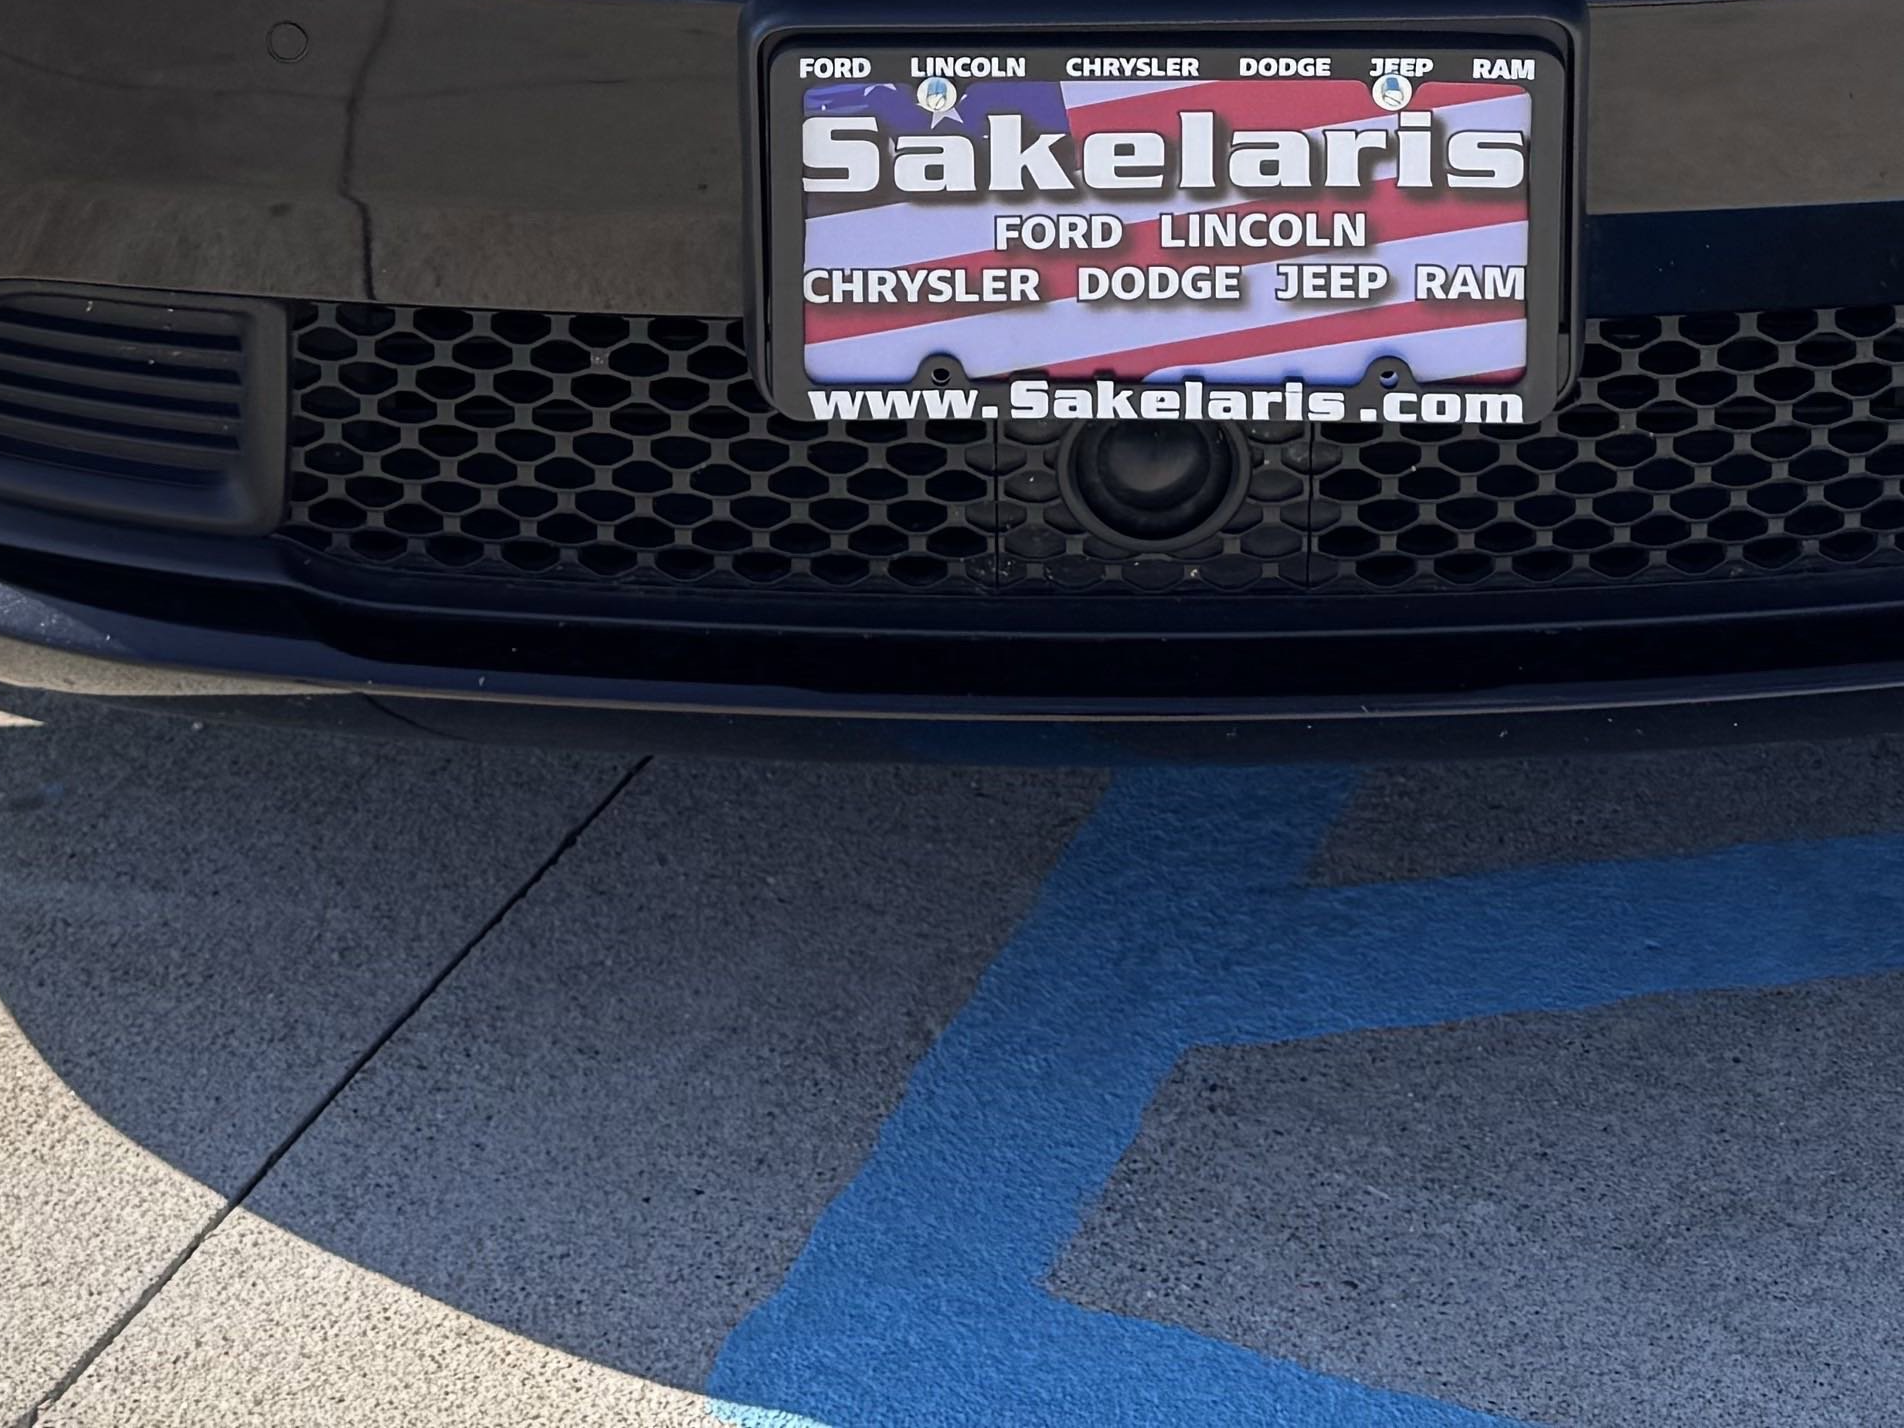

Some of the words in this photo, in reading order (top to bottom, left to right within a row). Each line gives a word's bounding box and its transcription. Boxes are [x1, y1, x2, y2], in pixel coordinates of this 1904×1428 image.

[799, 57, 872, 79] FORD
[910, 57, 1026, 79] LINCOLN
[1066, 57, 1200, 79] CHRYSLER
[1239, 57, 1331, 78] DODGE
[1369, 56, 1434, 78] JEEP
[1472, 58, 1536, 81] RAM
[802, 111, 1524, 194] Sakelaris
[994, 214, 1122, 252] FORD
[1160, 213, 1366, 248] LINCOLN
[803, 268, 1039, 303] CHRYSLER
[1077, 265, 1241, 301] DODGE
[1274, 264, 1389, 302] JEEP
[1415, 264, 1526, 300] RAM
[808, 380, 1524, 424] www.Sakelaris.com
